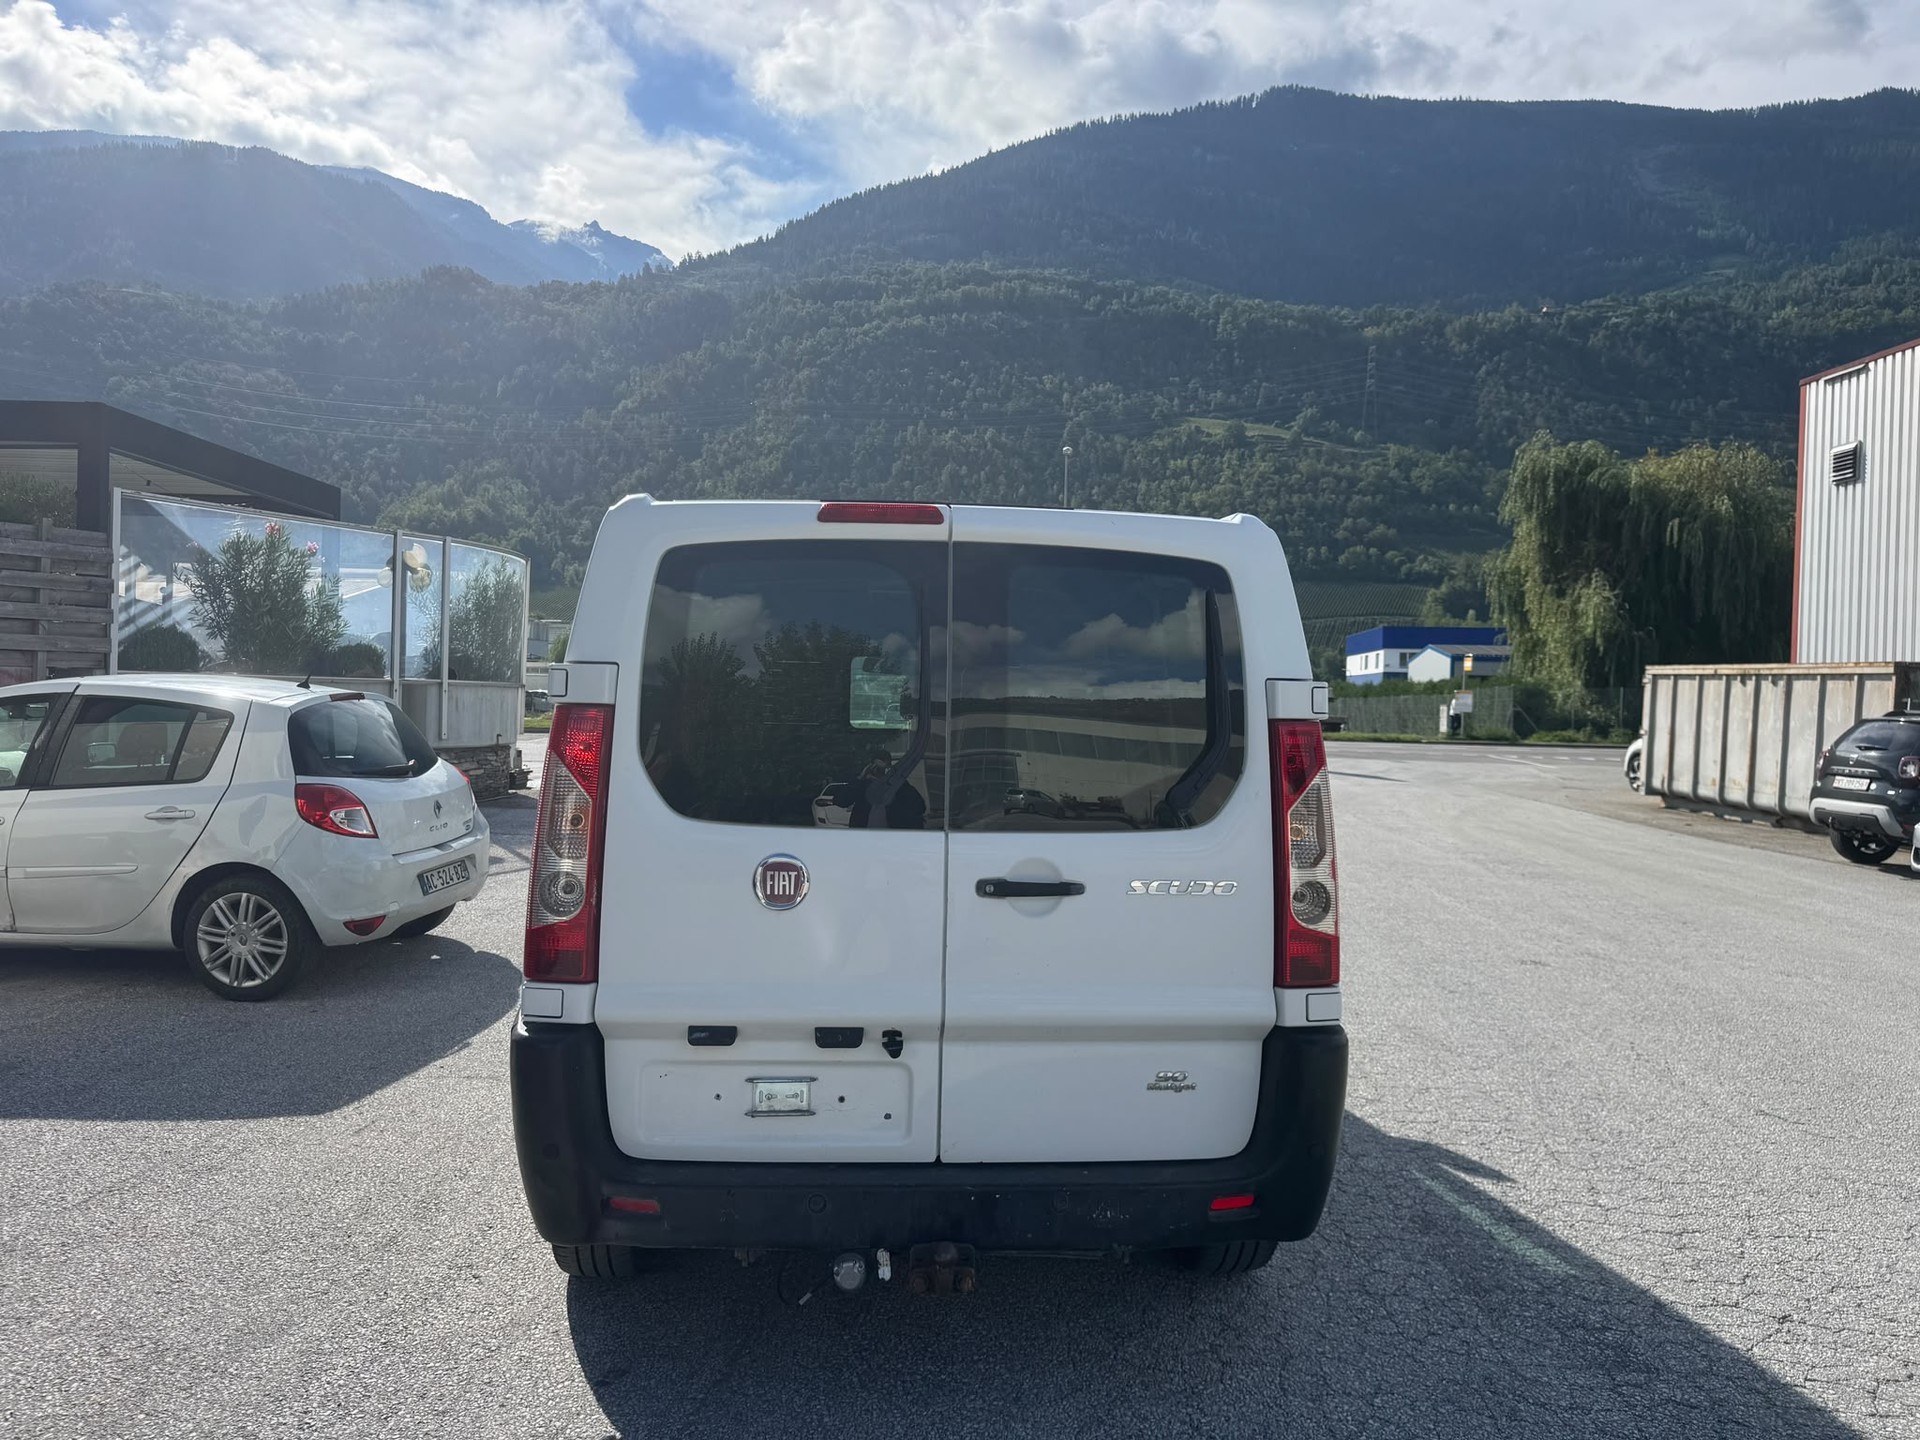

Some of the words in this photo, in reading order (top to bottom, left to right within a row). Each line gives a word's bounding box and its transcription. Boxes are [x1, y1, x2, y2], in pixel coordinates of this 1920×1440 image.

[429, 822, 448, 832] CLIO
[766, 870, 798, 895] FIAT
[1126, 879, 1238, 896] SCUDO
